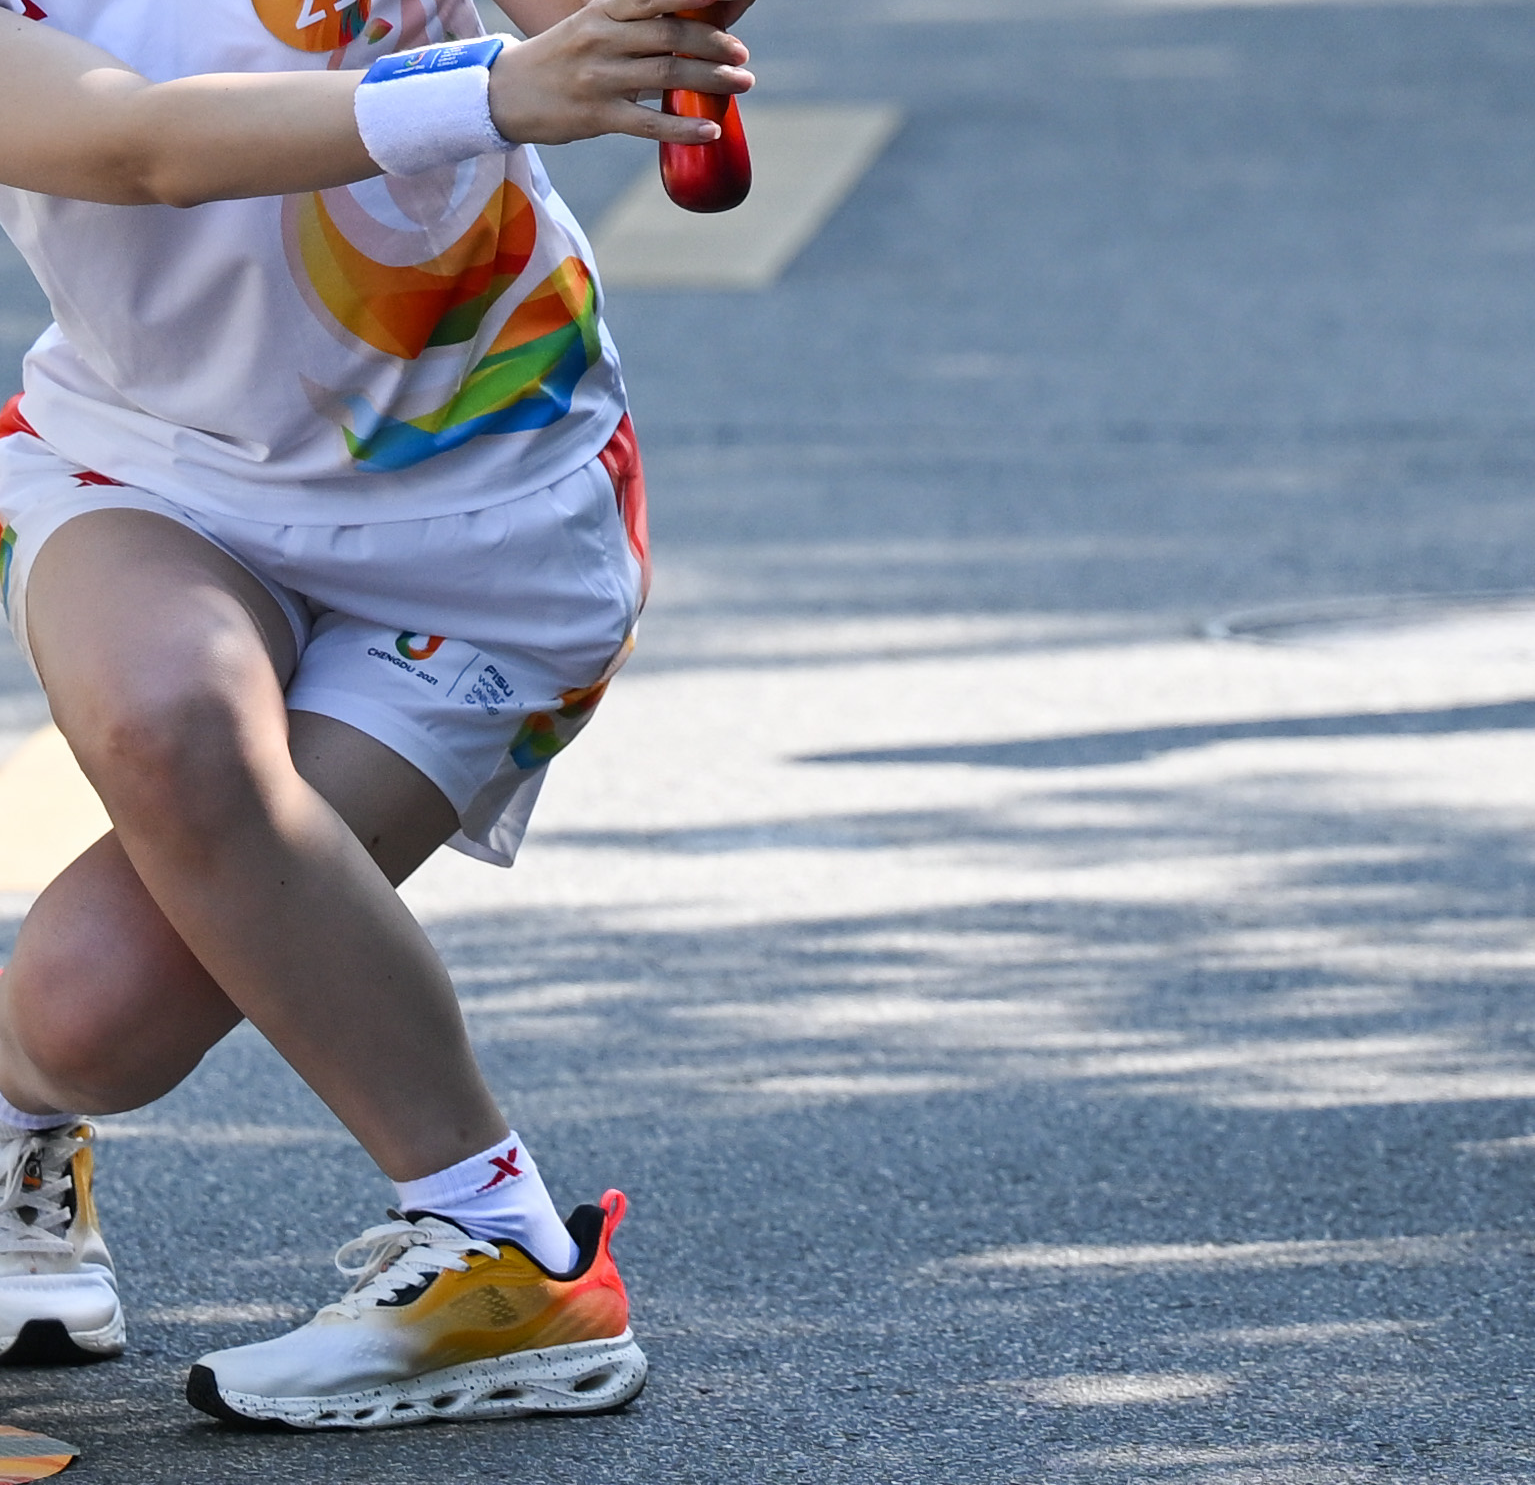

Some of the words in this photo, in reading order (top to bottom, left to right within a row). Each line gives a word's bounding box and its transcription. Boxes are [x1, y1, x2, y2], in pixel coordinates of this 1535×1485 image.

[367, 647, 416, 673] CHENGDU
[416, 671, 439, 686] 2021
[484, 665, 514, 697] FISU
